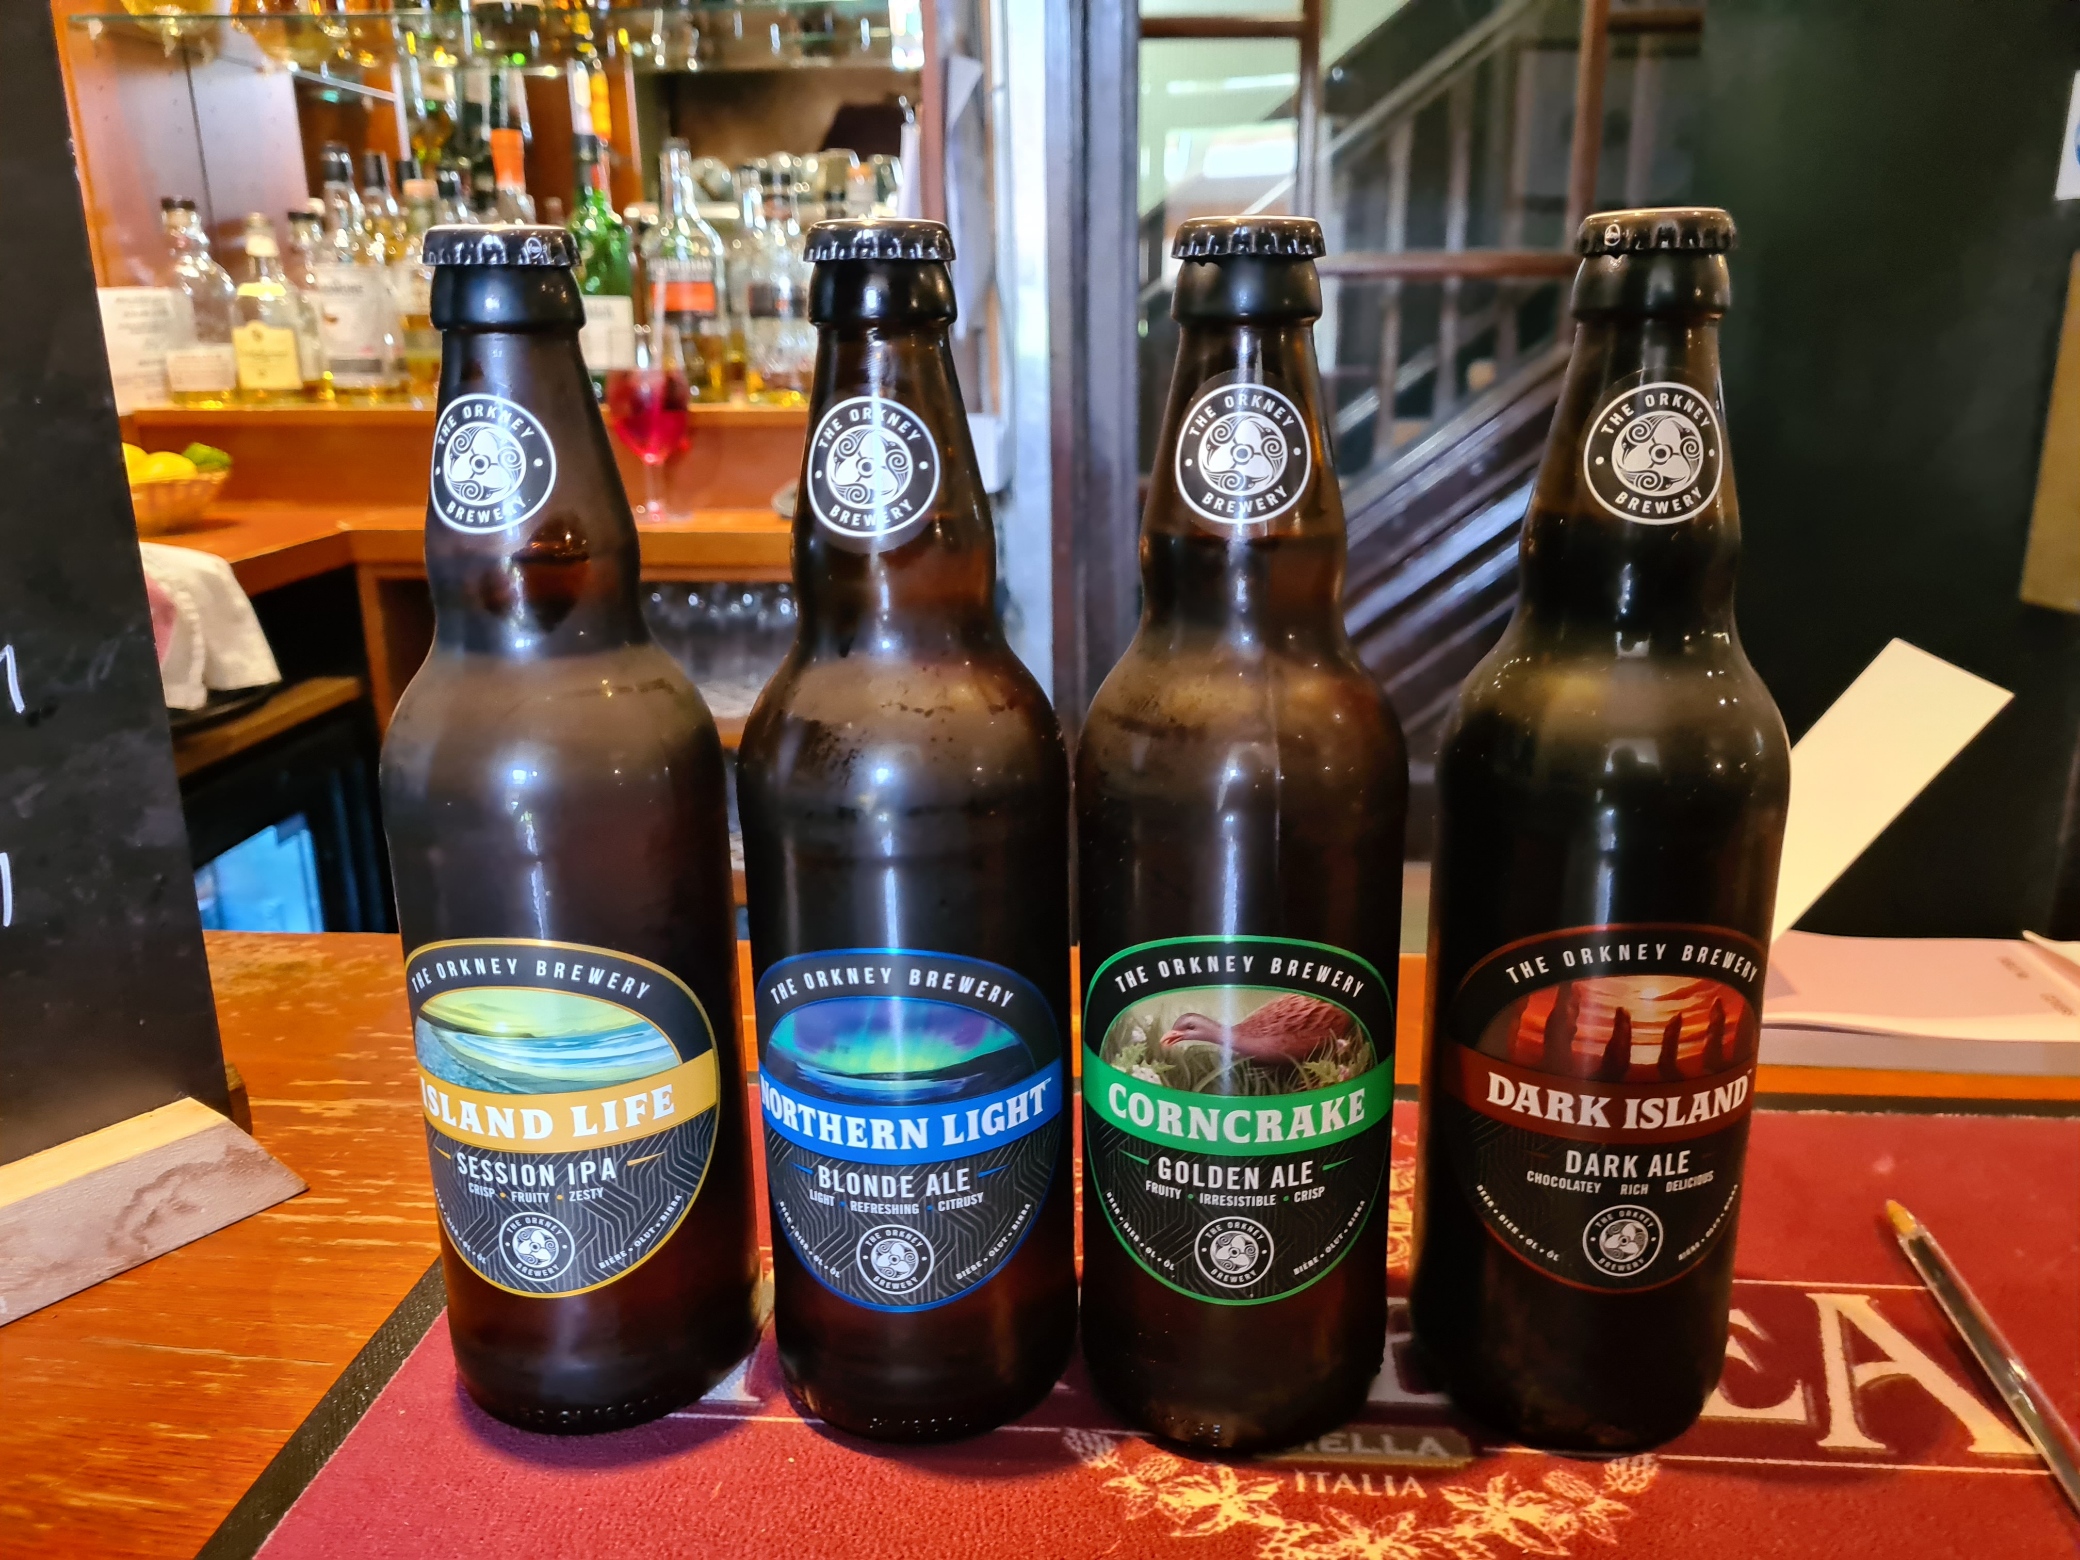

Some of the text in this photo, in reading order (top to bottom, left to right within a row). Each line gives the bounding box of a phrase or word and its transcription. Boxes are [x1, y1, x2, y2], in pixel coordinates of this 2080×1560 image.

[438, 404, 535, 445] THE ORKNEY
[818, 407, 921, 448] THE ORKNEY
[1189, 394, 1294, 436] THE ORKNEY
[1601, 393, 1710, 434] THE ORKNEY
[829, 499, 912, 526] BREWERY
[1202, 485, 1287, 513] BREWERY
[1615, 486, 1702, 514] BREWERY
[1115, 956, 1365, 998] THE ORKNEY BREWERY
[1506, 943, 1759, 984] THE ORKNEY BREWERY
[411, 958, 650, 1000] THE ORKNEY BREWERY
[770, 967, 1015, 1008] THE ORKNEY BREWERY
[420, 1076, 675, 1140] ISLAND LIFE
[760, 1074, 1047, 1149] NORTHERN LIGHT
[1108, 1082, 1366, 1143] CORNCRAKE
[1487, 1072, 1748, 1129] DARK ISLAND
[456, 1152, 617, 1187] SESSION IPA
[1158, 1156, 1314, 1190] GOLDEN ALE
[1565, 1150, 1691, 1179] DARK ALE
[468, 1182, 604, 1203] CRISP FRUITY ZESTY
[818, 1164, 971, 1198] BLONDE ALE
[1145, 1180, 1325, 1207] FRUITY IRRESISTIBLE CRISP
[1527, 1170, 1714, 1195] CHOCOLATEY RICH DELICIOUS
[809, 1189, 984, 1215] LIGHT REFRESHING CITRUSY
[506, 1217, 563, 1235] THE ORKNEY
[1205, 1221, 1265, 1241] THE ORKNEY
[1594, 1210, 1654, 1229] THE ORKNEY
[634, 1227, 656, 1247] OLUT
[865, 1229, 924, 1248] THE ORKNEY
[989, 1237, 1008, 1257] OLUT
[515, 1263, 560, 1277] BREWERY
[1210, 1268, 1257, 1283] BREWERY
[1598, 1257, 1645, 1272] BREWERY
[873, 1275, 919, 1290] BREWERY
[1295, 1468, 1428, 1499] ITALIA
